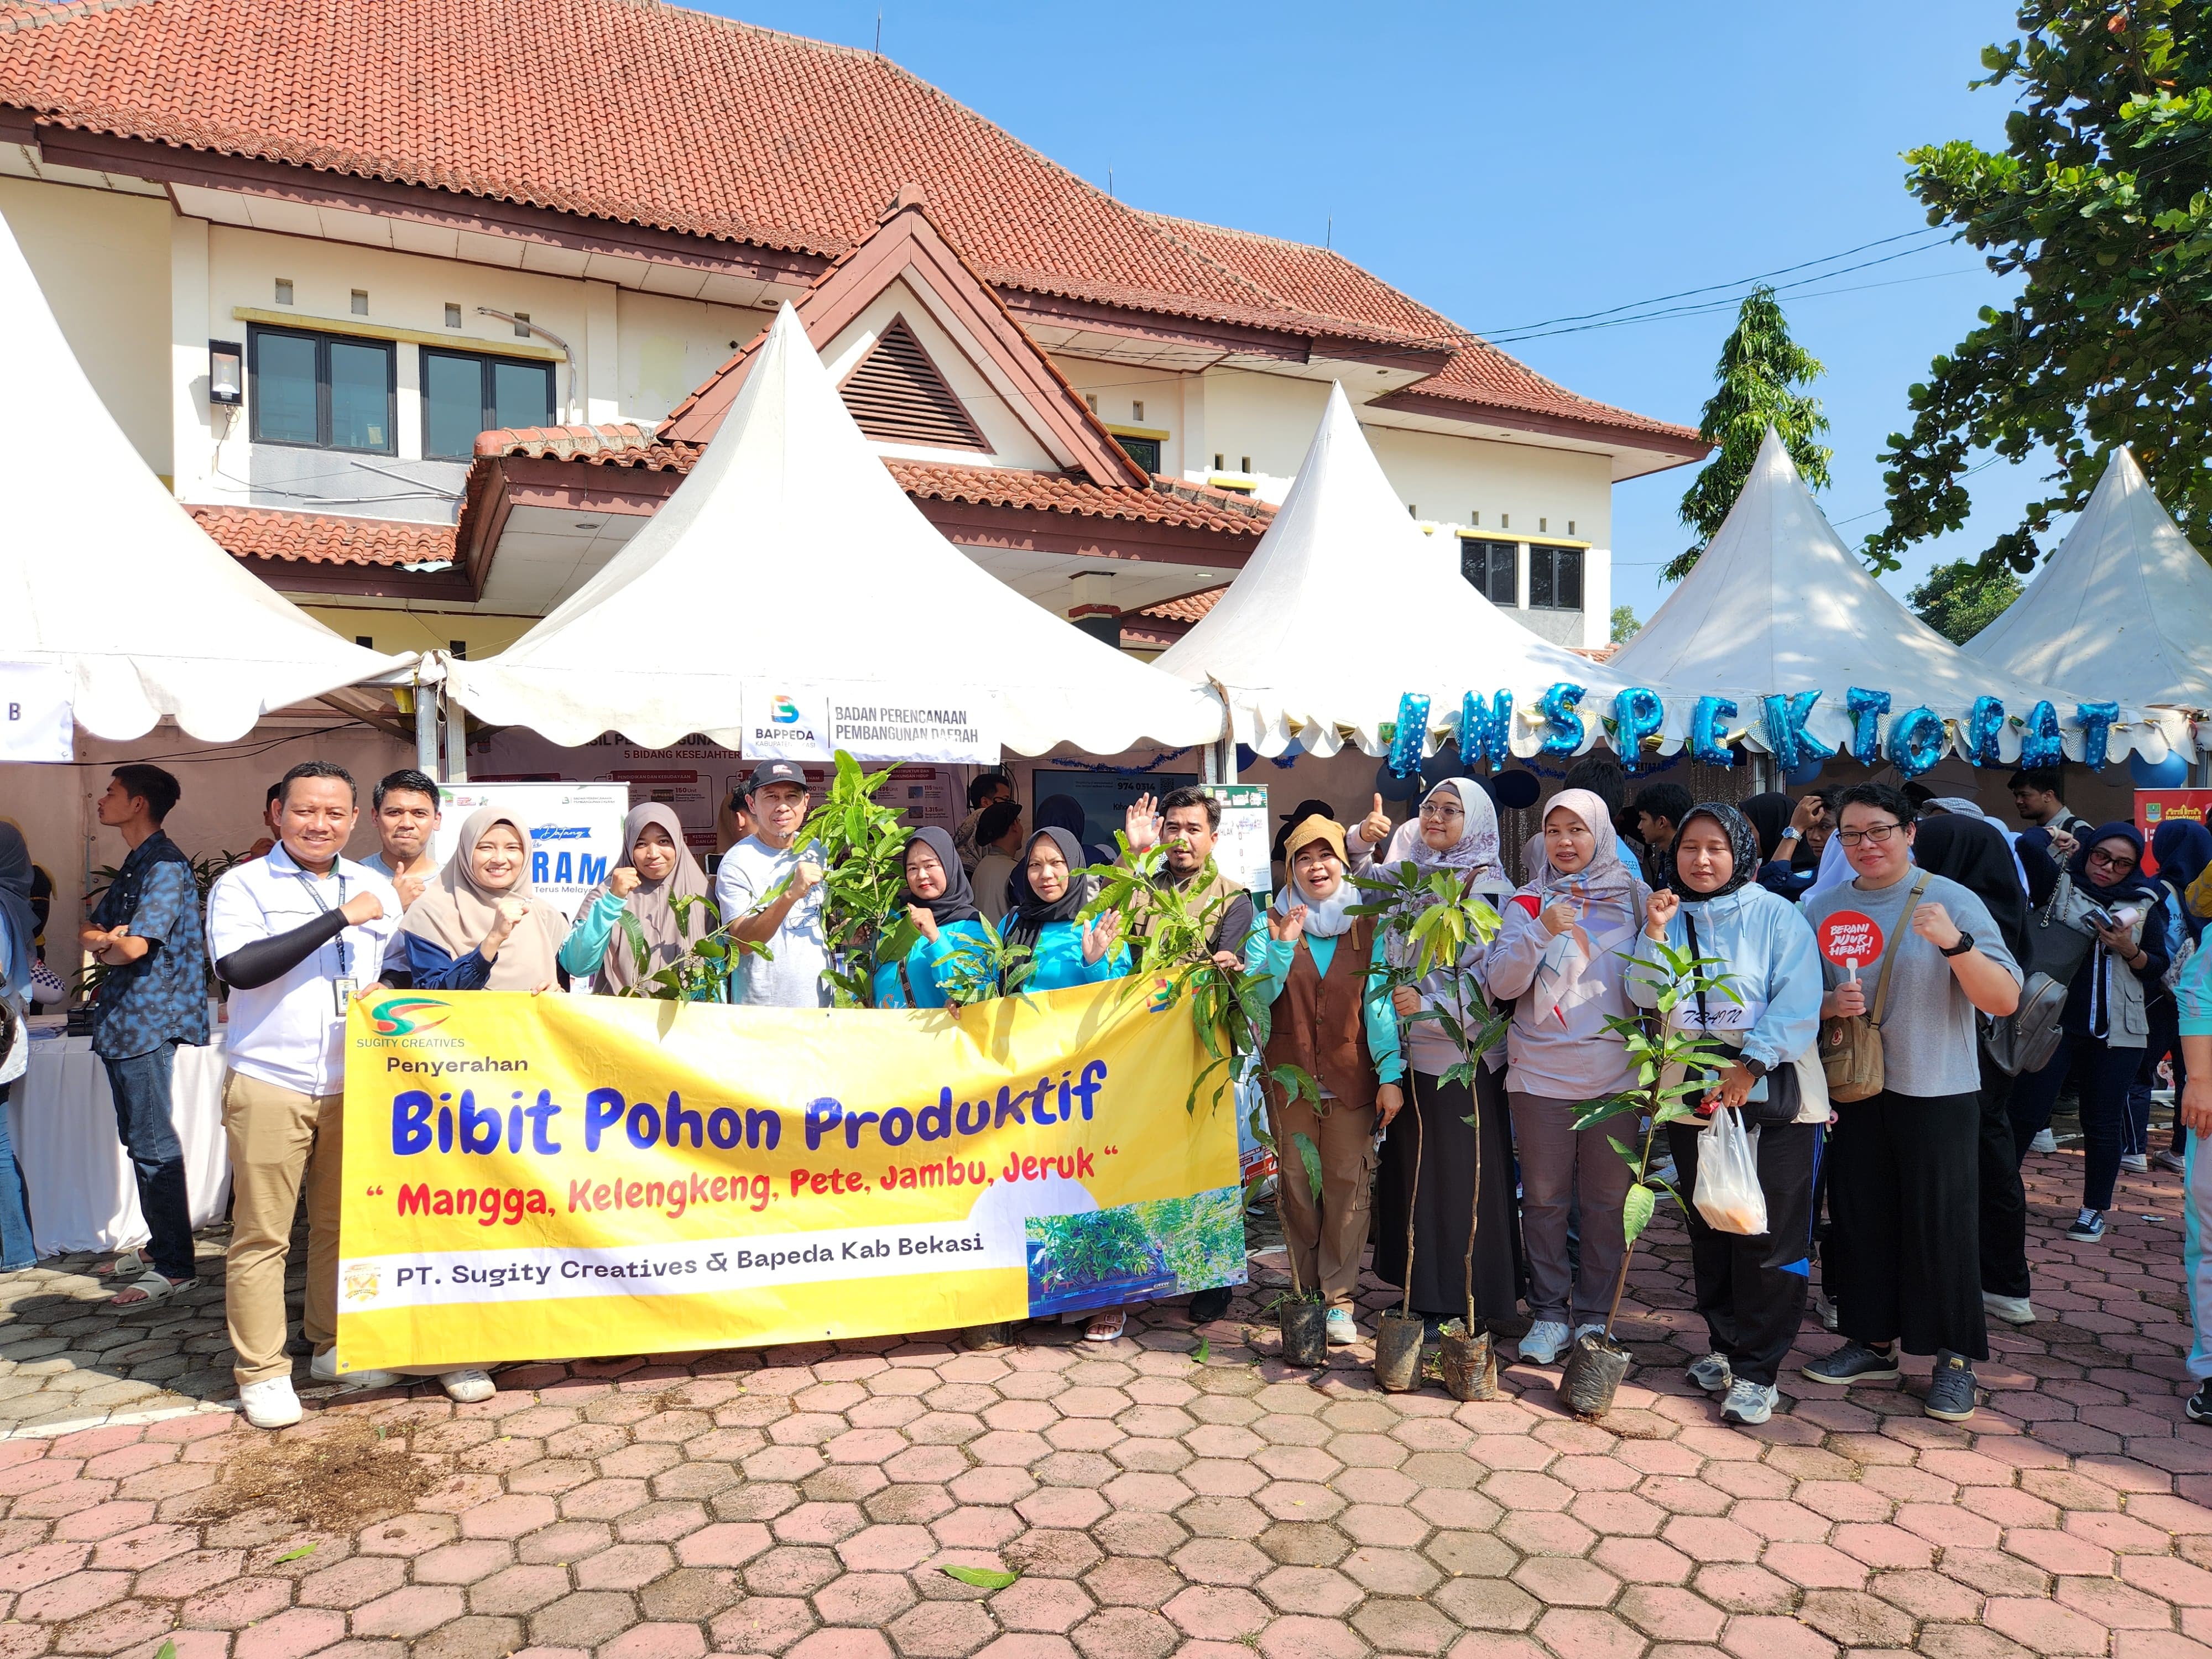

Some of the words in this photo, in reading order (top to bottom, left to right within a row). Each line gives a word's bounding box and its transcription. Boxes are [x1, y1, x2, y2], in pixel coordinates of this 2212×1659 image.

[8, 702, 22, 721] B
[835, 706, 877, 722] BADAN
[880, 708, 967, 724] PERENCANAAN
[755, 728, 815, 740] BAPPEDA
[836, 725, 928, 741] PEMBANGUNAN
[624, 750, 630, 759] 5
[633, 750, 674, 759] BIDANG
[675, 750, 742, 759] KESEJAHTER
[1117, 782, 1134, 790] 974
[532, 851, 607, 885] RAM
[1830, 923, 1870, 936] BERANI
[1682, 1008, 1743, 1024] TRAIN
[356, 1038, 399, 1048] SUGITY
[401, 1038, 465, 1048] CREATIVES
[387, 1056, 528, 1077] Penyerahan
[391, 1088, 562, 1155] Bibit
[585, 1087, 782, 1151] Pohon
[805, 1059, 1108, 1151] Produktif
[397, 1182, 556, 1227] Mangga,
[567, 1171, 780, 1219] Kelengkeng,
[789, 1168, 872, 1198] Pete,
[879, 1155, 994, 1190] Jambu,
[1001, 1146, 1095, 1183] Jeruk
[397, 1265, 442, 1287] PT.
[451, 1264, 552, 1287] Sugity
[560, 1258, 697, 1280] Creatives
[705, 1251, 728, 1273] &
[737, 1243, 833, 1271] Bapeda
[841, 1238, 891, 1260] Kab
[898, 1232, 985, 1256] Bekasi
